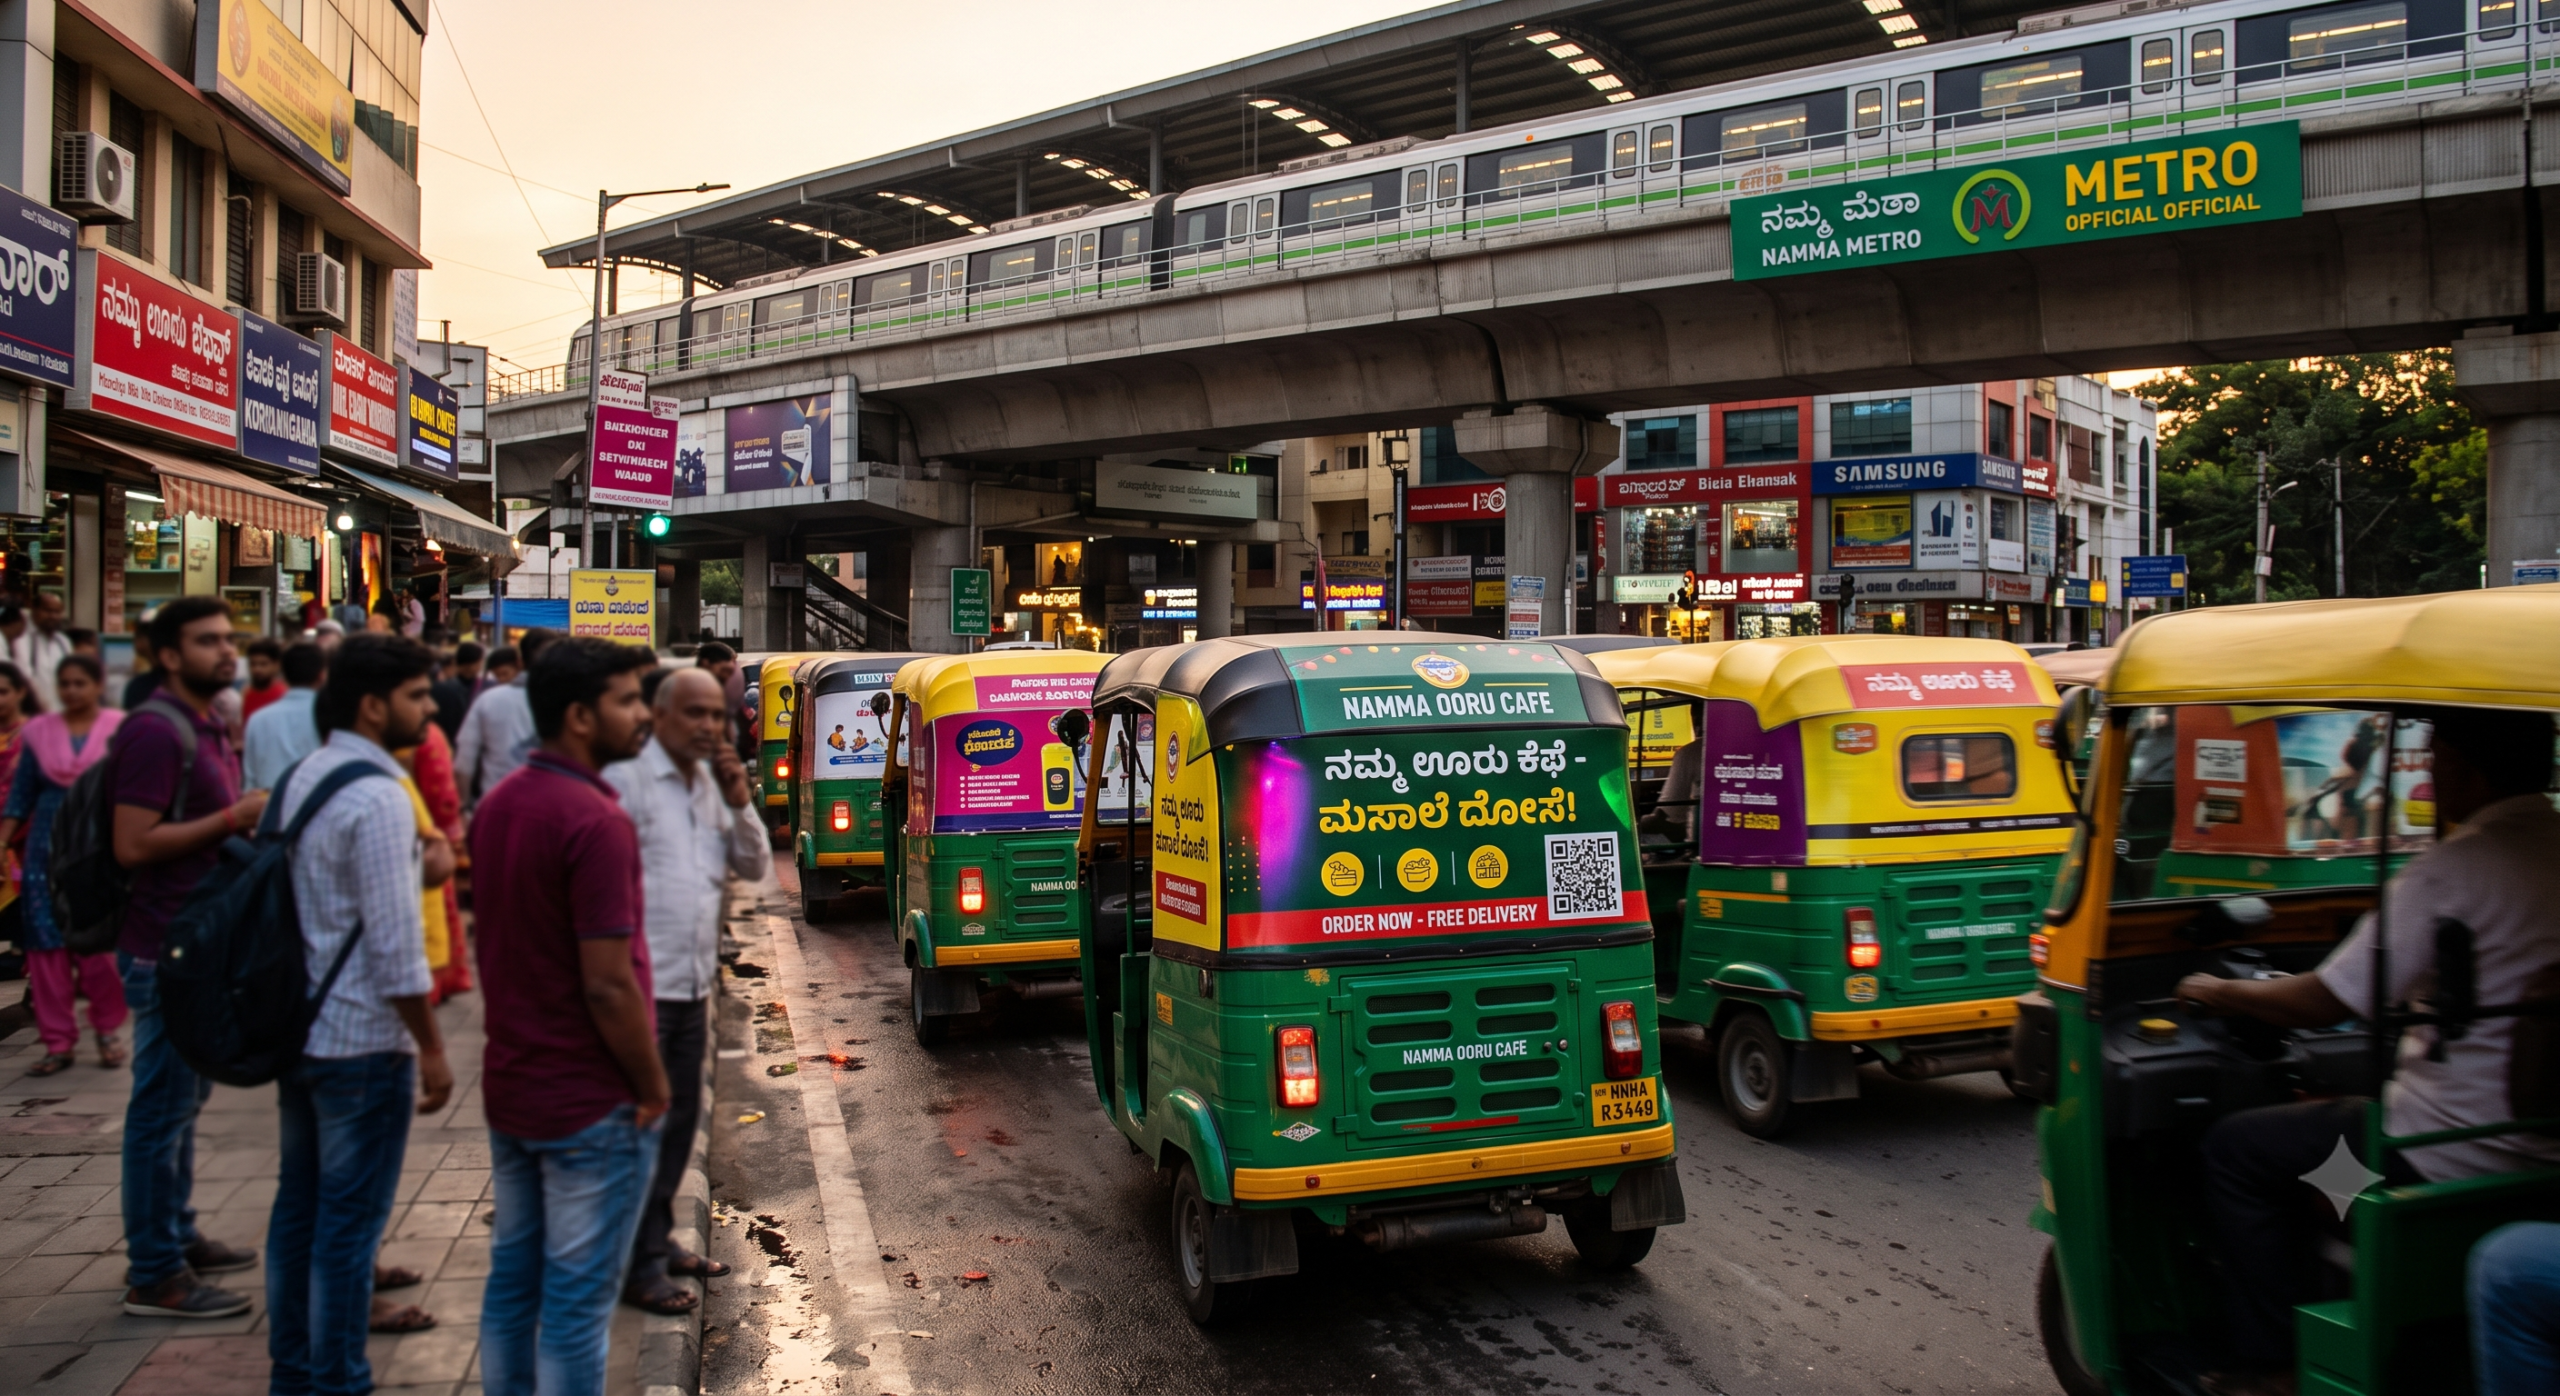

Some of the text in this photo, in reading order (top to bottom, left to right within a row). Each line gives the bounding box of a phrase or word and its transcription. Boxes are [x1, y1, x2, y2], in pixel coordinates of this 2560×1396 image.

[2066, 141, 2258, 206] METRO
[1761, 200, 1834, 239] ನಮ್ಮ
[2066, 193, 2261, 232] OPFICIAL OFFICIAL
[1762, 229, 1922, 267] NAMMA METRO
[1834, 460, 1946, 484] SAMSUNG
[1342, 691, 1554, 720] NAMMA OORU CAFE
[1325, 748, 1409, 794] ನಮ್ಮ
[1413, 744, 1508, 777] ಊರು
[1517, 739, 1566, 779] ಕೆಫೆ
[1319, 787, 1577, 834] ಮಸಾಲೆ ದೋಸೆ!
[1031, 881, 1064, 892] NAMMA
[1322, 914, 1375, 934] ORDER
[1378, 911, 1413, 931] NOW
[1427, 909, 1464, 928] FREE
[1468, 903, 1538, 925] DELIVERY
[1403, 1040, 1527, 1065] NAMMA OORU CAFE
